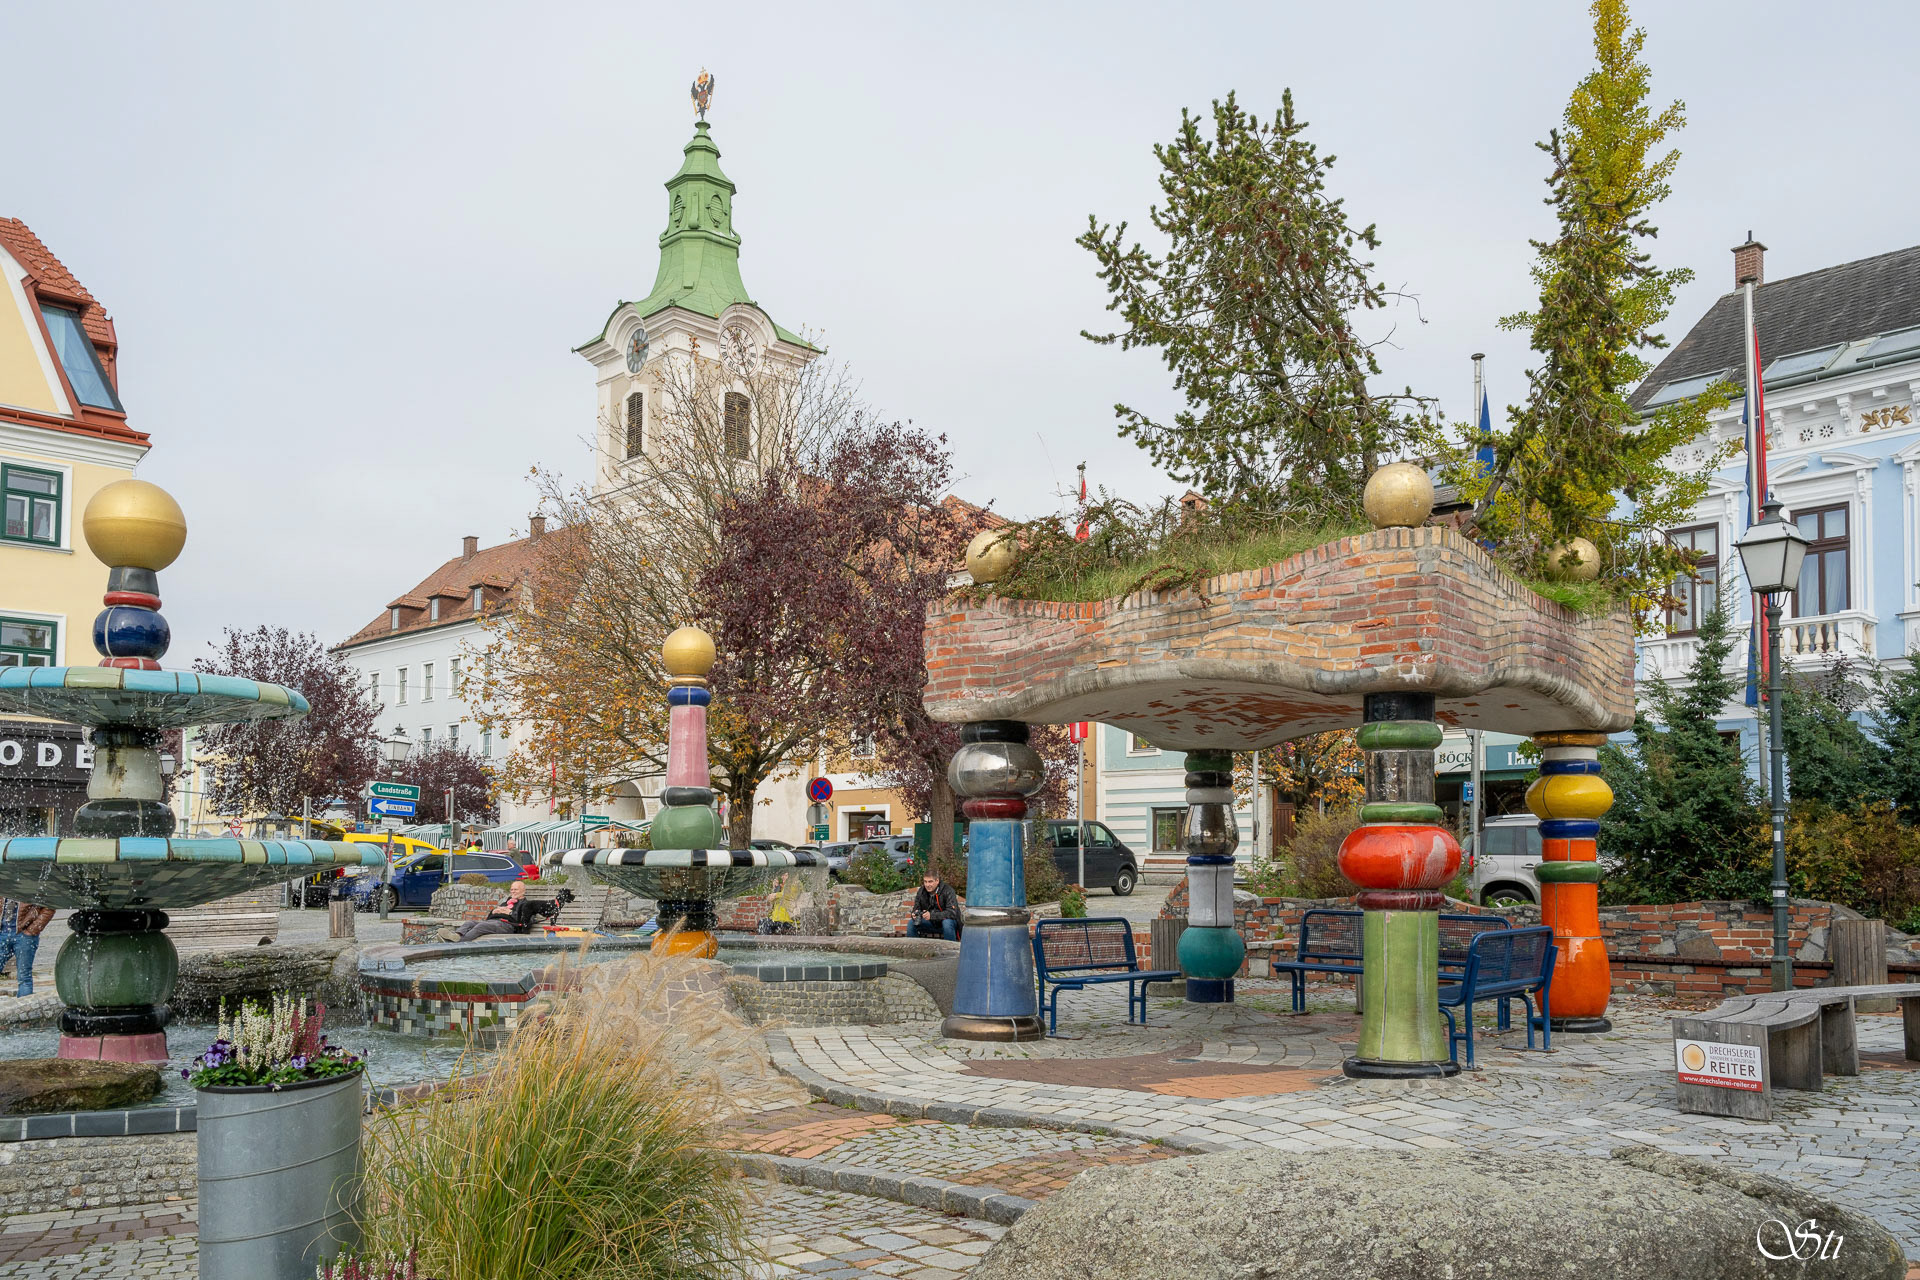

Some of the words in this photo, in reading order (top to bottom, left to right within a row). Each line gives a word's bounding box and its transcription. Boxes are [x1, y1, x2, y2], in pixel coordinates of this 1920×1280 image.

[377, 785, 413, 796] Landstraße
[1709, 1046, 1756, 1059] DRECHSLEREI
[1710, 1061, 1757, 1077] REITER
[1683, 1075, 1757, 1089] www.drechslerei-reiter.at
